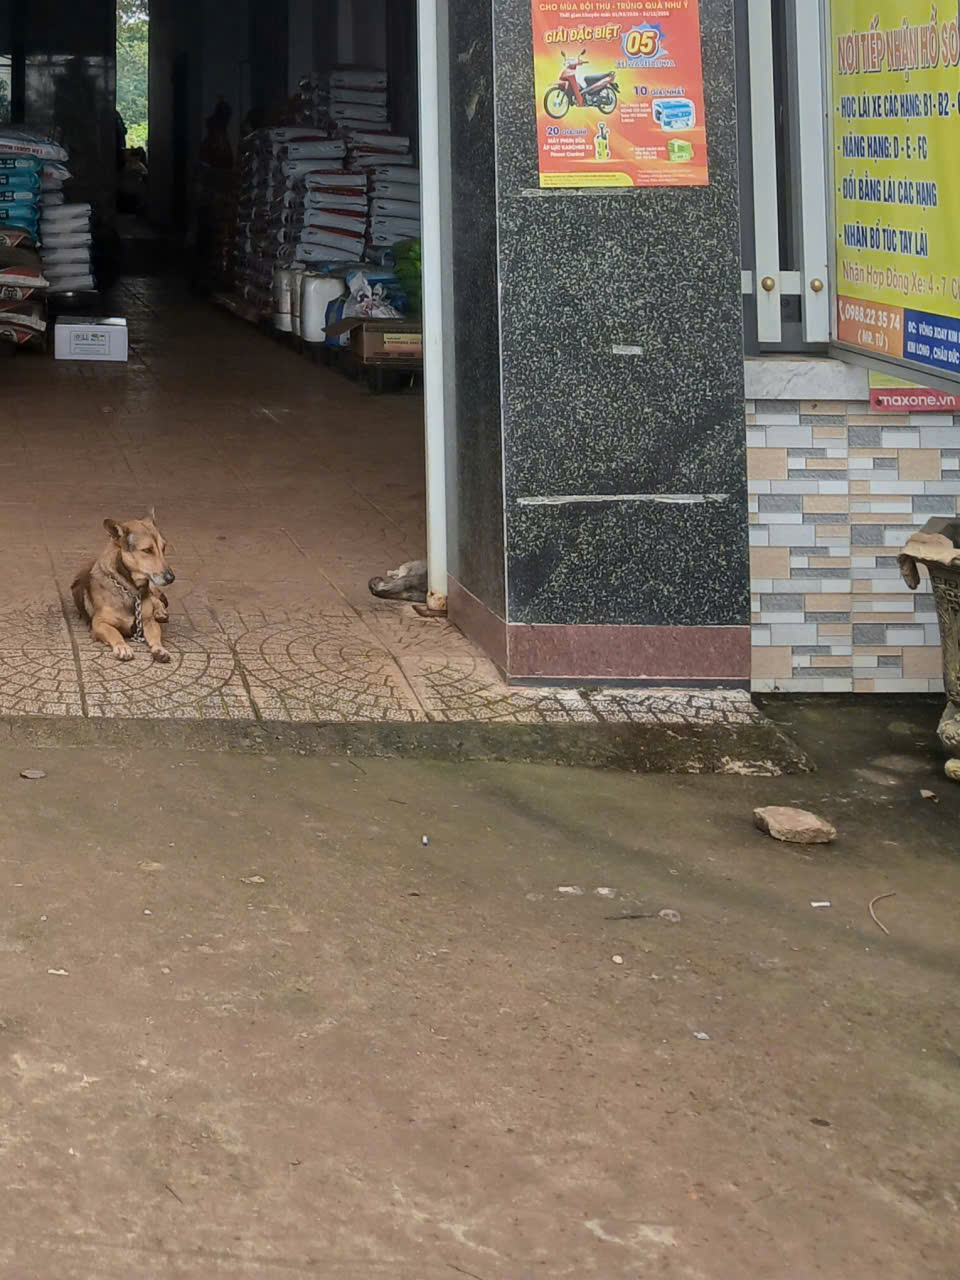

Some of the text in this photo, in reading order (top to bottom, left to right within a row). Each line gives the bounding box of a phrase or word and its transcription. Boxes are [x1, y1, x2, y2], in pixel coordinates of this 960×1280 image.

[539, 3, 557, 11] CHO
[544, 24, 620, 44] GIẢI ĐẶC BIỆT
[626, 30, 657, 56] 05
[860, 15, 886, 73] TIẾP
[886, 17, 919, 82] NHẬN
[920, 3, 940, 68] HỒ
[633, 85, 648, 97] 10
[841, 96, 856, 123] HỌC
[858, 91, 870, 117] LÁI
[872, 95, 882, 117] XE
[884, 90, 899, 117] CÁC
[938, 92, 949, 116] B2
[546, 125, 560, 135] 20
[893, 135, 899, 158] D
[906, 136, 911, 159] E
[918, 136, 928, 159] FC
[858, 170, 882, 201] BẰNG
[883, 175, 896, 203] LÁI
[898, 176, 914, 204] CÁC
[916, 182, 937, 211] HẠNG
[843, 220, 868, 252] NHẬN
[882, 224, 897, 252] TÚC
[899, 230, 913, 254] TAY
[915, 226, 928, 256] LÁI
[842, 259, 865, 284] Nhận
[866, 264, 884, 290] Hợp
[928, 275, 935, 294] 4
[941, 276, 947, 297] 7
[879, 394, 956, 407] maxone.vn
